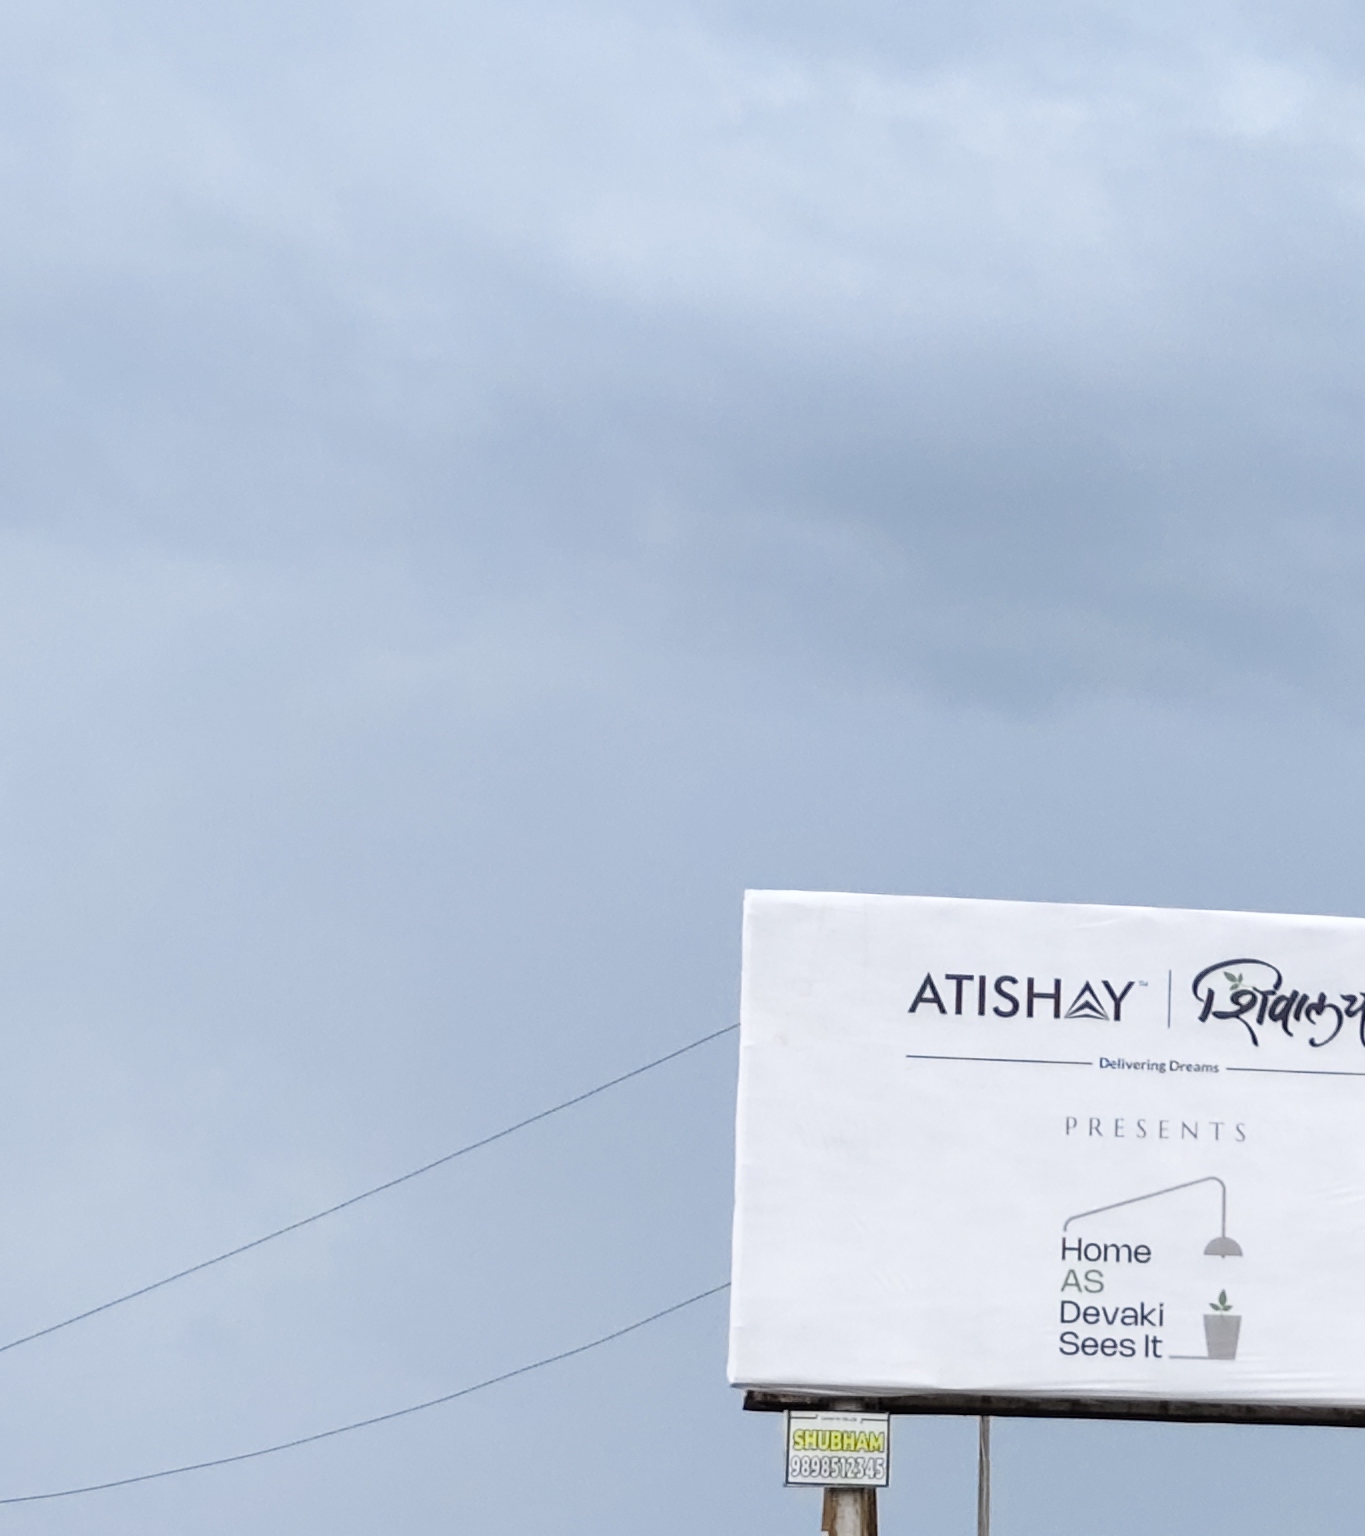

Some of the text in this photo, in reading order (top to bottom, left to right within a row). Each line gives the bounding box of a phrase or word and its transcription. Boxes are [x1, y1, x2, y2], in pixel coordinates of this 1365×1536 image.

[907, 971, 1136, 1022] ATISHAY
[1099, 1057, 1219, 1075] Delivering Dreams
[1064, 1115, 1249, 1143] PRESENTS
[1061, 1236, 1152, 1264] Home
[1060, 1268, 1105, 1294] AS
[1059, 1299, 1164, 1327] Devaki
[1058, 1331, 1163, 1359] Sees It
[792, 1428, 886, 1453] SHUBHAM
[790, 1455, 886, 1480] 9898512345
